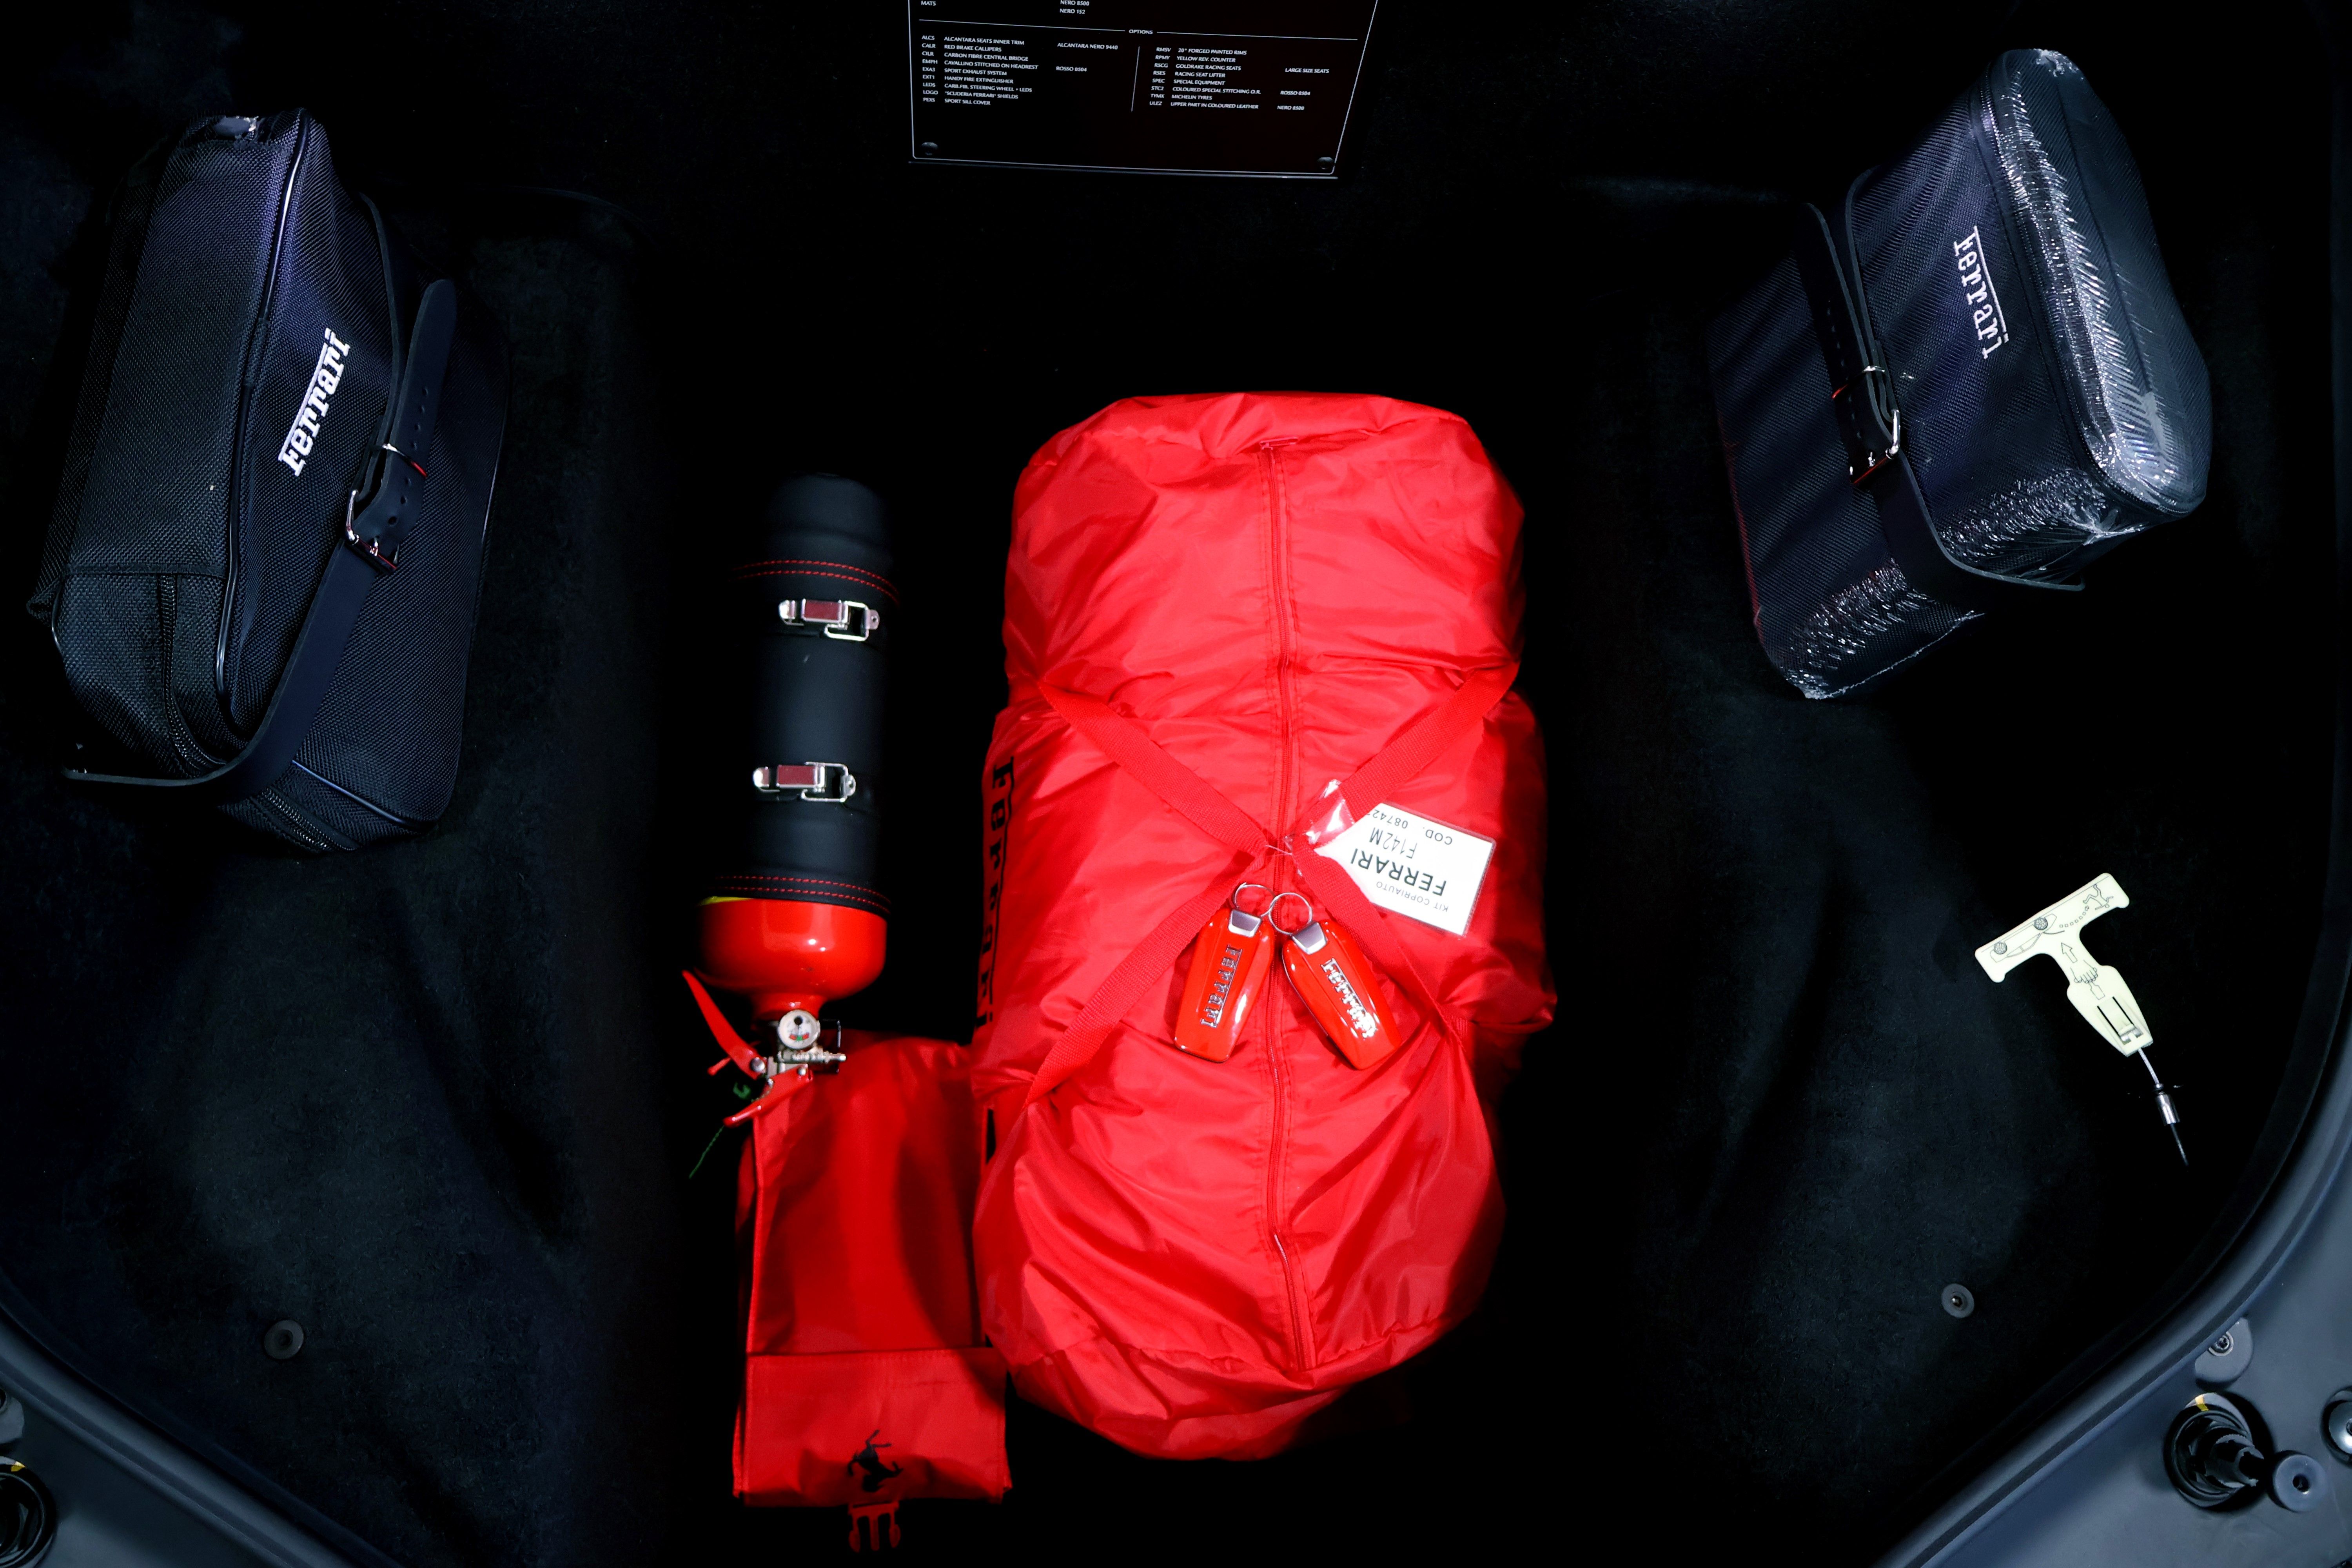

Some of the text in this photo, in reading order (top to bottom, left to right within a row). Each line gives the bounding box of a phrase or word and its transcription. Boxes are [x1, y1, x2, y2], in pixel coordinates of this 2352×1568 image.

[1953, 225, 2009, 359] Ferrari
[278, 328, 350, 477] Ferrari
[1367, 809, 1453, 845] COD. 08742
[1369, 827, 1418, 859] F142M
[1350, 848, 1447, 897] FERRARI
[1375, 880, 1449, 913] KIT COPRIAUTO
[1200, 944, 1243, 1028] Ferrari
